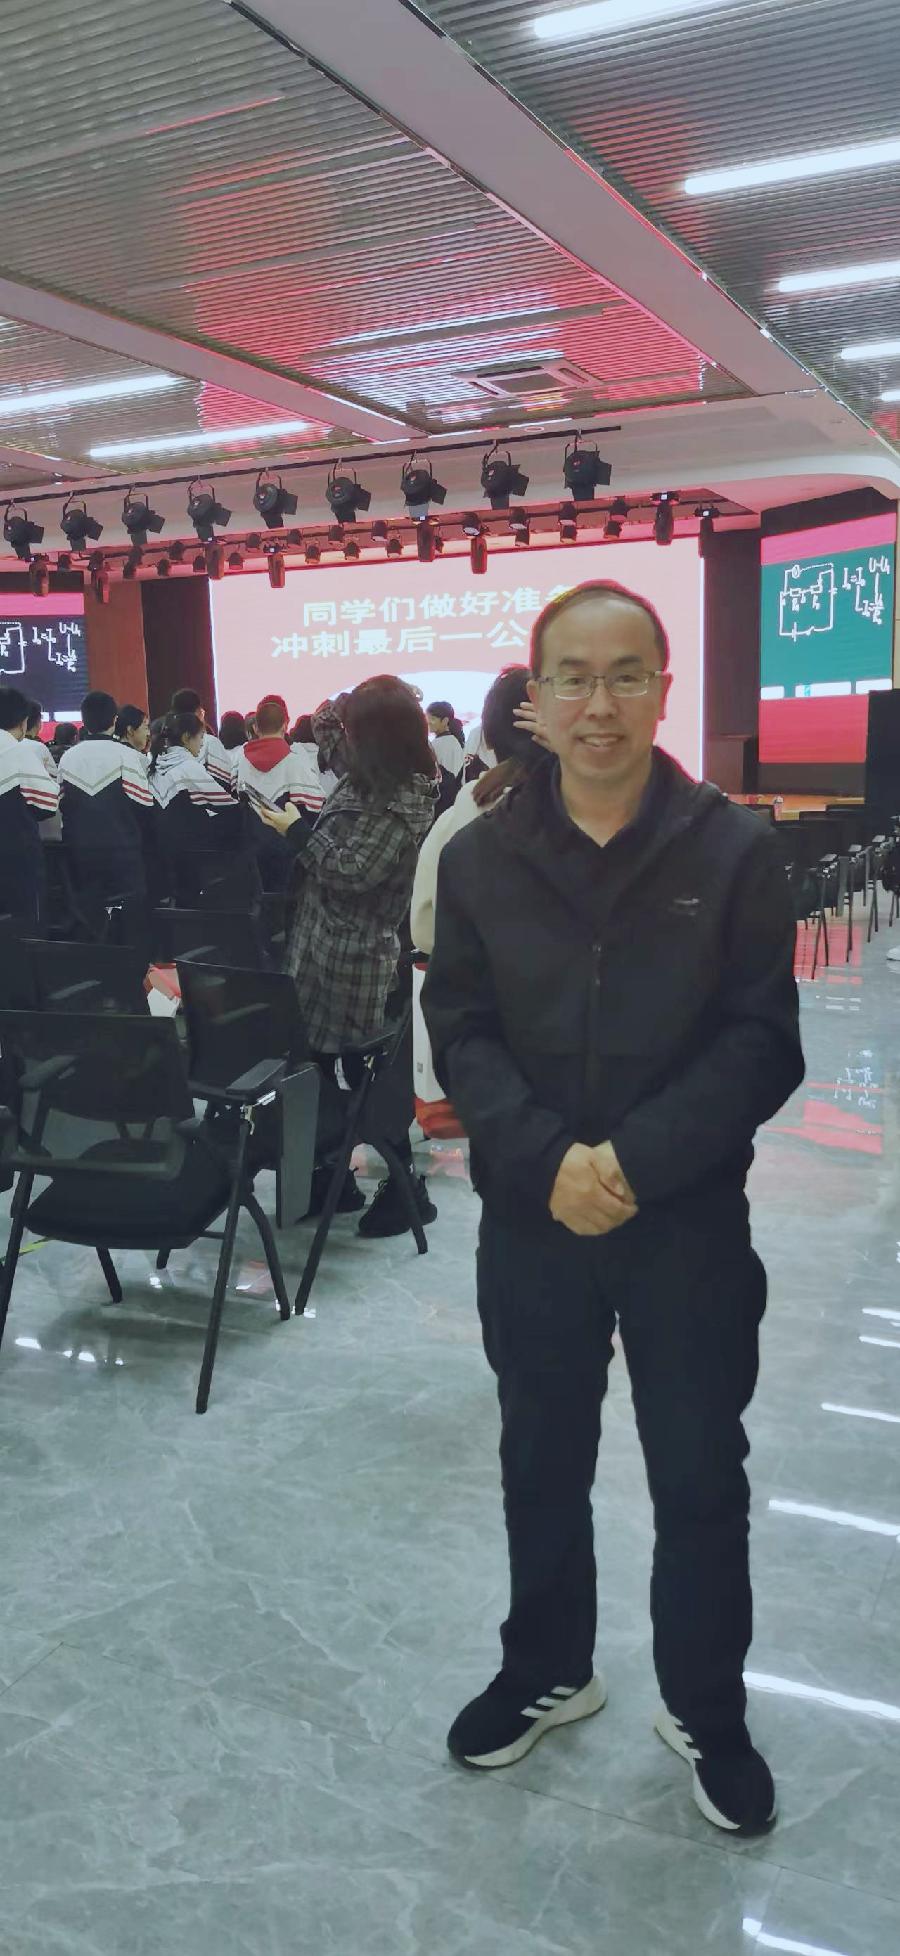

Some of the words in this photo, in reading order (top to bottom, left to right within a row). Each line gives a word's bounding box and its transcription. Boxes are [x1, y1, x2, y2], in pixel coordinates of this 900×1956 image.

[270, 620, 527, 659] 冲刺最后一公
